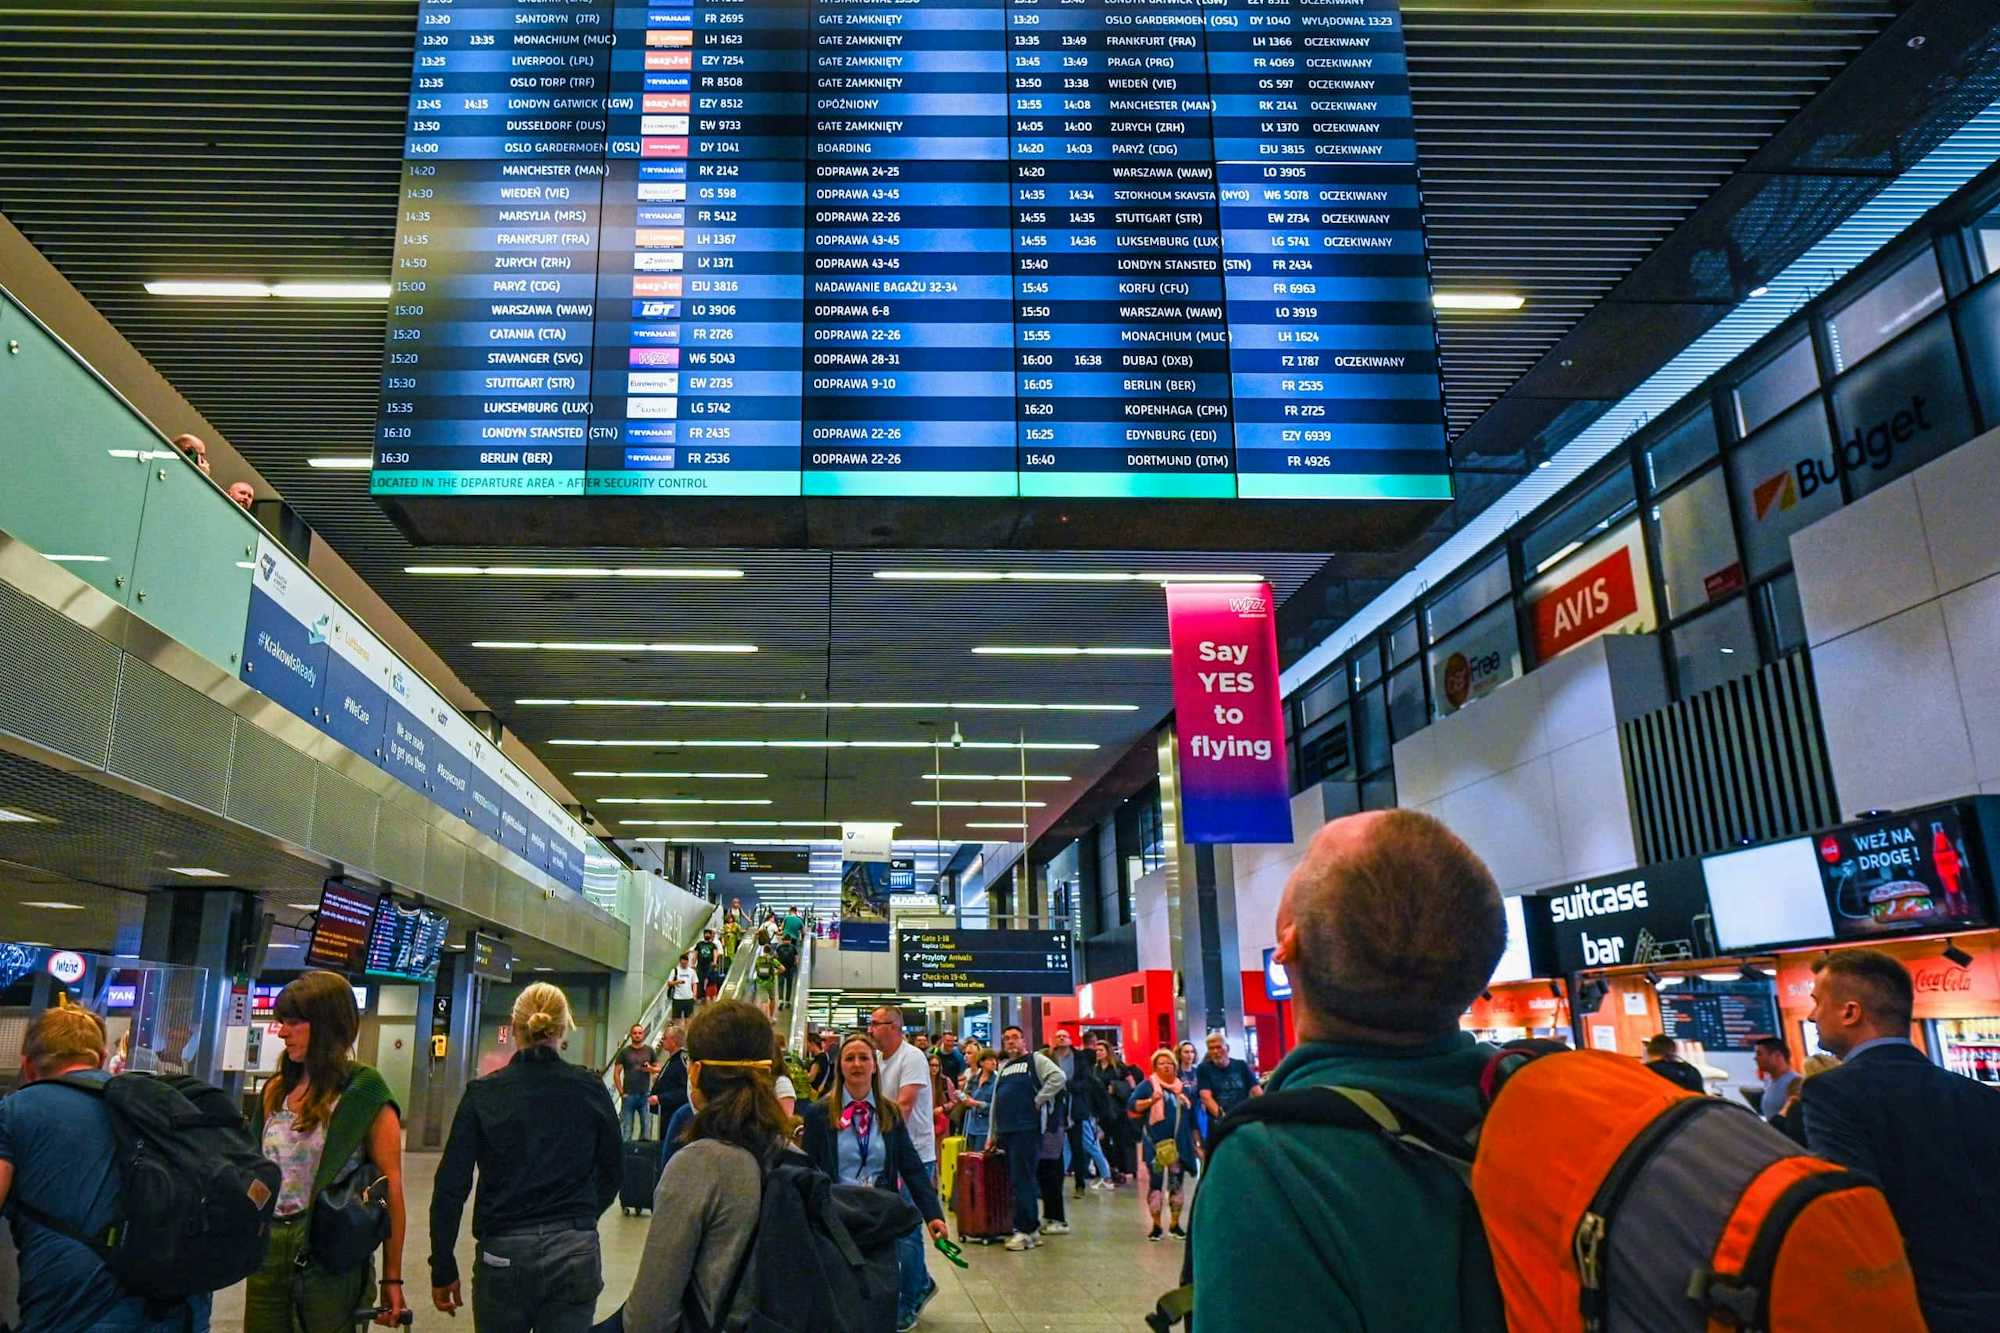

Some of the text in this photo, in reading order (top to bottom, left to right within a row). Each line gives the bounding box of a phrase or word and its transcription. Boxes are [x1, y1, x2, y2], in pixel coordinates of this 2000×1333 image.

[422, 57, 446, 66] 13:25
[512, 56, 565, 66] LIVERPOOL
[570, 56, 594, 66] (LPL)
[702, 56, 720, 65] EZY
[722, 56, 744, 65] 7254
[818, 57, 842, 66] GATE
[846, 56, 902, 68] ZAMKNIĘTY
[1016, 57, 1372, 68] 13:45 13:49 PRAGA (PRG) FR 4069 OCZEKIWANY
[416, 100, 441, 109] 13:45
[464, 100, 488, 109] 14:15
[509, 99, 550, 108] LONDYN
[554, 99, 598, 108] GATWICK
[602, 98, 633, 110] (LGW)
[700, 98, 718, 108] EZY
[720, 99, 743, 108] 8512
[818, 98, 878, 109] OPÓŹNIONY
[410, 166, 435, 175] 14:20
[503, 165, 571, 176] MANCHESTER
[575, 165, 609, 176] (MAN)
[700, 166, 714, 175] RK
[717, 166, 738, 175] 2142
[817, 167, 868, 176] ODPRAWA
[868, 167, 899, 176] 24-25
[1020, 190, 1387, 201] 14:35 14:34 SZTOKHOLM SKAVSTA (NYO) W6 5078 OCZEKIWANY
[398, 280, 957, 293] 15:00 PARYŻ (CDG) EJU 3816 NADAWANIE BAGAŻU 32-34
[396, 306, 423, 315] 15:00
[492, 305, 552, 315] WARSZAWA
[556, 304, 592, 316] (WAW)
[693, 305, 706, 315] LO
[708, 305, 736, 315] 3906
[815, 306, 868, 316] ODPRAWA
[872, 306, 890, 316] 6-8
[391, 354, 418, 363] 15:20
[488, 353, 549, 363] STAVANGER
[553, 352, 583, 365] (SVG)
[689, 353, 706, 363] W6
[710, 353, 735, 364] 5043
[814, 354, 868, 364] ODPRAWA
[872, 354, 900, 364] 28-31
[1023, 355, 1404, 368] 16:00 16:38 DUBAJ (DXB) FZ 1787 OCZEKIWANY
[384, 428, 411, 438] 16:10
[482, 428, 526, 438] LONDYN
[530, 428, 583, 438] STANSTED
[589, 427, 618, 440] (STN)
[690, 428, 703, 438] FR
[706, 428, 730, 438] 2435
[813, 428, 868, 438] ODPRAWA
[872, 428, 901, 439] 22-26
[1026, 429, 1331, 442] 16:25 EDYNBURG (EDI) EZY 6939
[1796, 396, 1932, 498] Budget
[382, 453, 409, 463] 16:30
[480, 453, 518, 463] BERLIN
[522, 452, 552, 465] (BER)
[688, 453, 701, 463] FR
[704, 453, 730, 464] 2536
[813, 454, 868, 464] ODPRAWA
[871, 454, 901, 464] 22-26
[1027, 454, 1330, 468] 16:40 DORTMUND (DTM) FR 4926
[372, 478, 418, 488] LOCATED
[422, 478, 434, 488] IN
[438, 478, 458, 488] THE
[461, 478, 523, 488] DEPARTURE
[526, 478, 554, 488] AREA
[566, 478, 600, 488] AFTER
[604, 478, 655, 488] SECURITY
[658, 478, 708, 488] CONTROL
[1554, 578, 1608, 638] AVIS
[258, 630, 317, 688] #KrakowIsReady
[1198, 641, 1248, 665] Say
[1198, 672, 1254, 693] YES
[344, 696, 370, 726] #WeCare
[1214, 704, 1243, 724] to
[1191, 736, 1271, 760] flying
[1890, 827, 1916, 845] NA
[1858, 848, 1912, 870] DROGĘ
[1550, 880, 1649, 922] suitcase
[1581, 932, 1624, 966] bar
